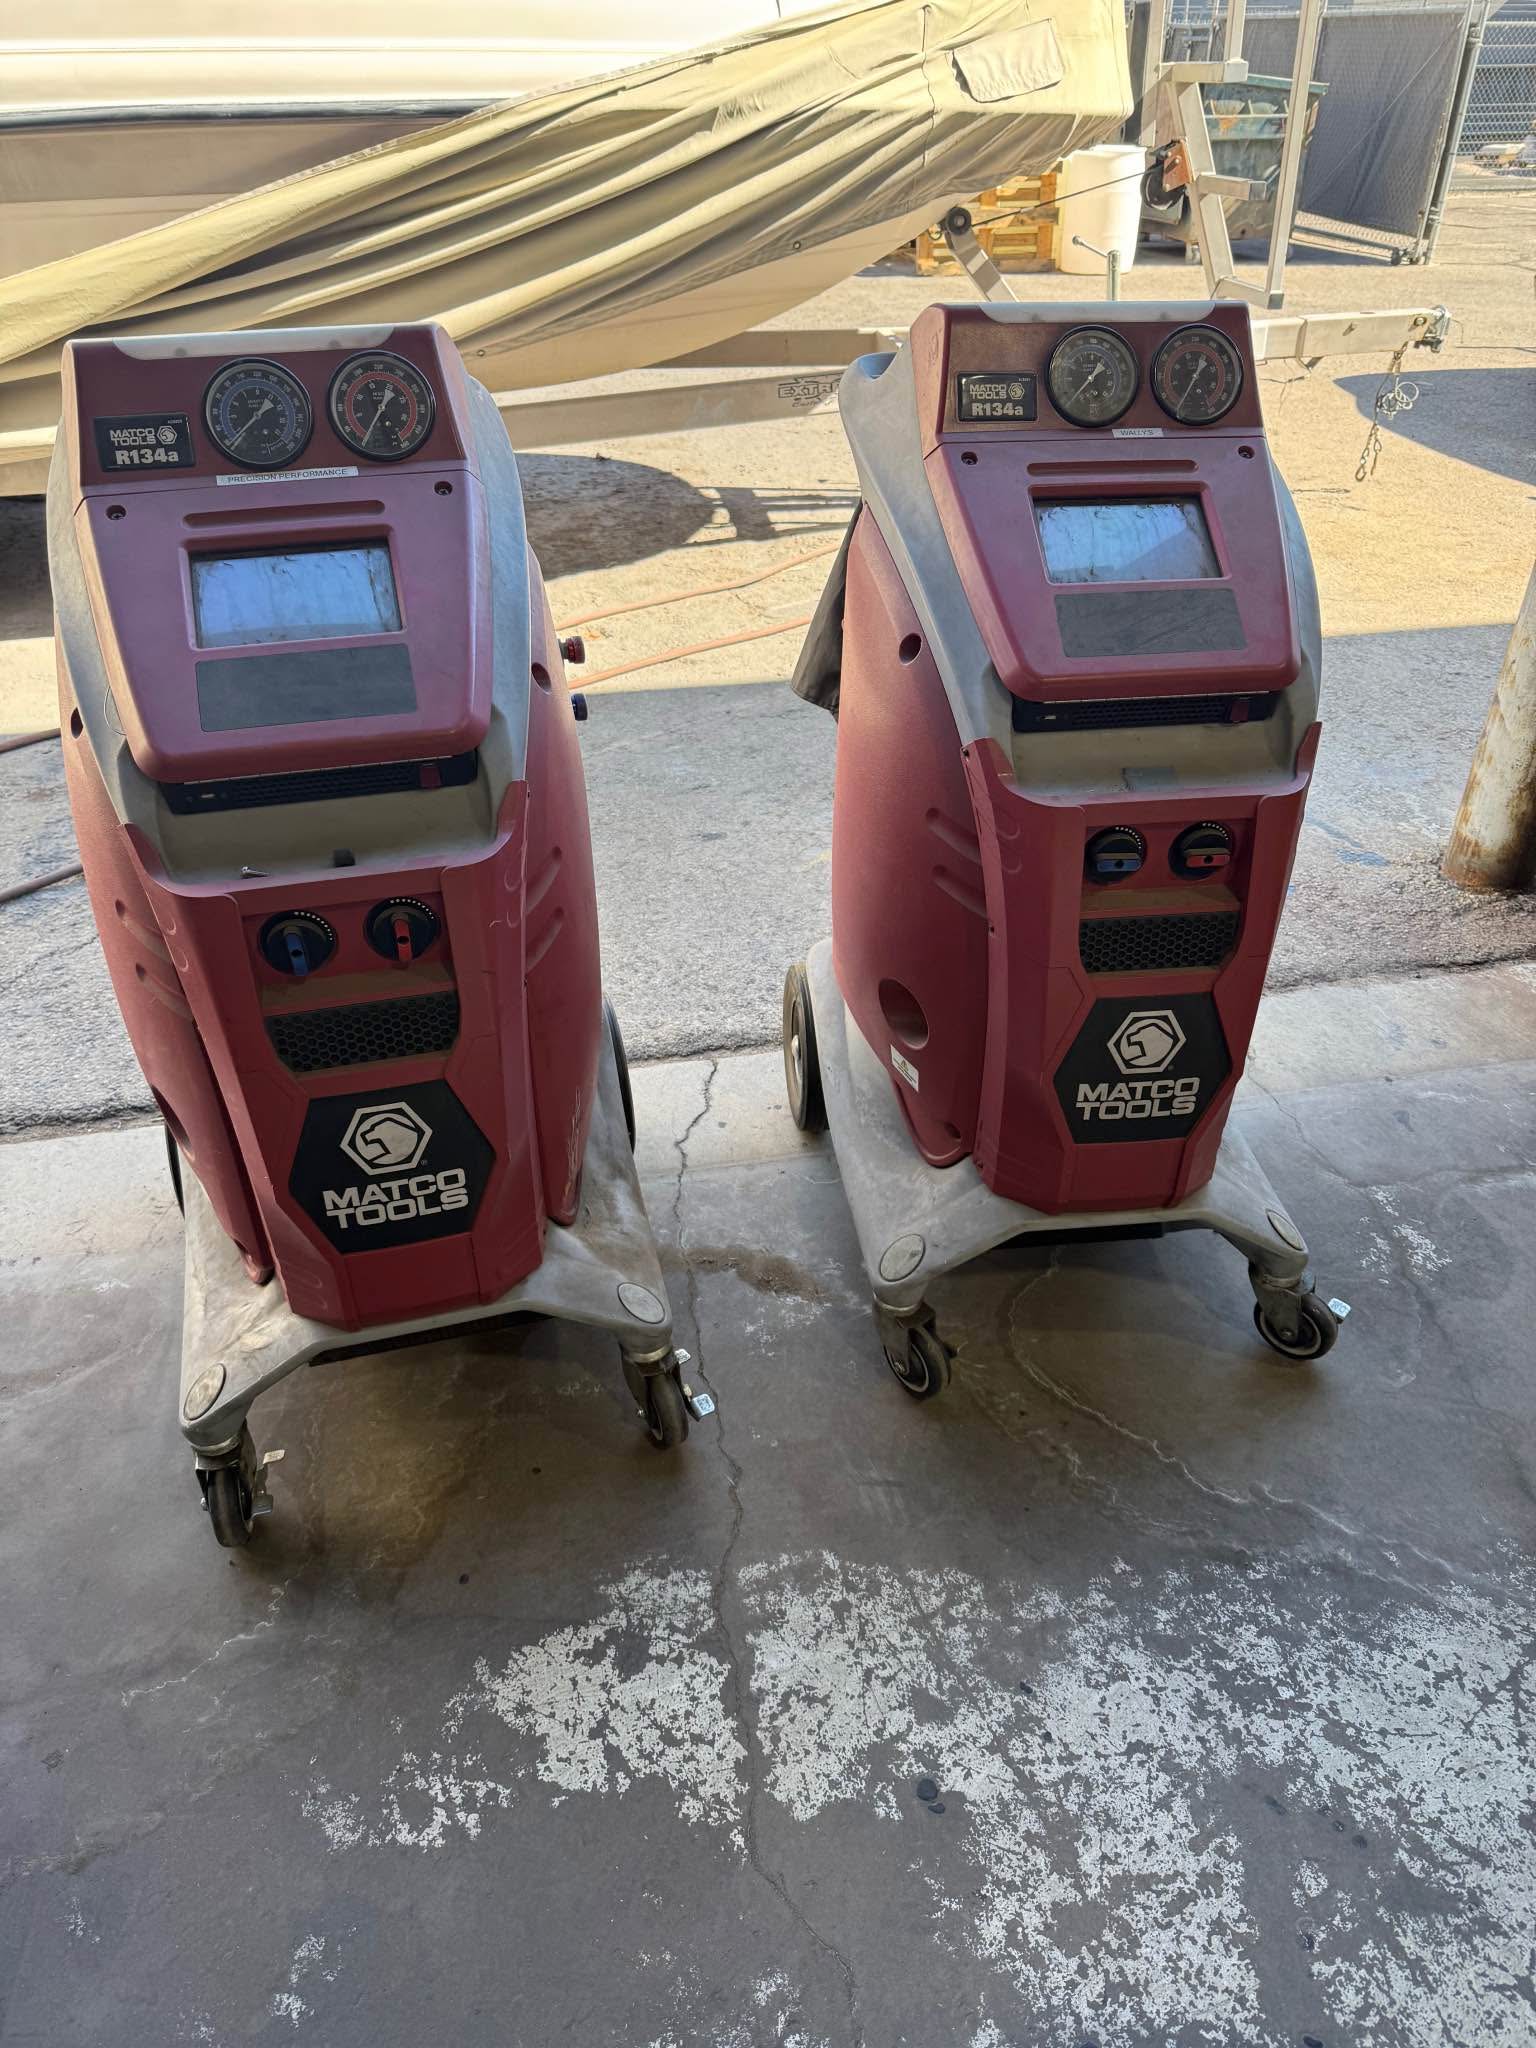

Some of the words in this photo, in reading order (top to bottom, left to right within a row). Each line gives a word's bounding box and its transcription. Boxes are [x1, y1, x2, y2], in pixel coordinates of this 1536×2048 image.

[969, 384, 1007, 392] MATCO
[969, 391, 1007, 400] TOOLS
[971, 402, 1024, 416] R134a
[109, 428, 155, 440] MATCO
[111, 435, 157, 446] TOOLS
[115, 448, 179, 465] R134a
[227, 472, 277, 483] PRECISION
[279, 468, 348, 481] PERFORMANCE
[1077, 1077, 1200, 1102] MATCO
[1076, 1095, 1197, 1120] TOOLS
[322, 1167, 466, 1210] MATCO
[326, 1187, 469, 1229] TOOLS
